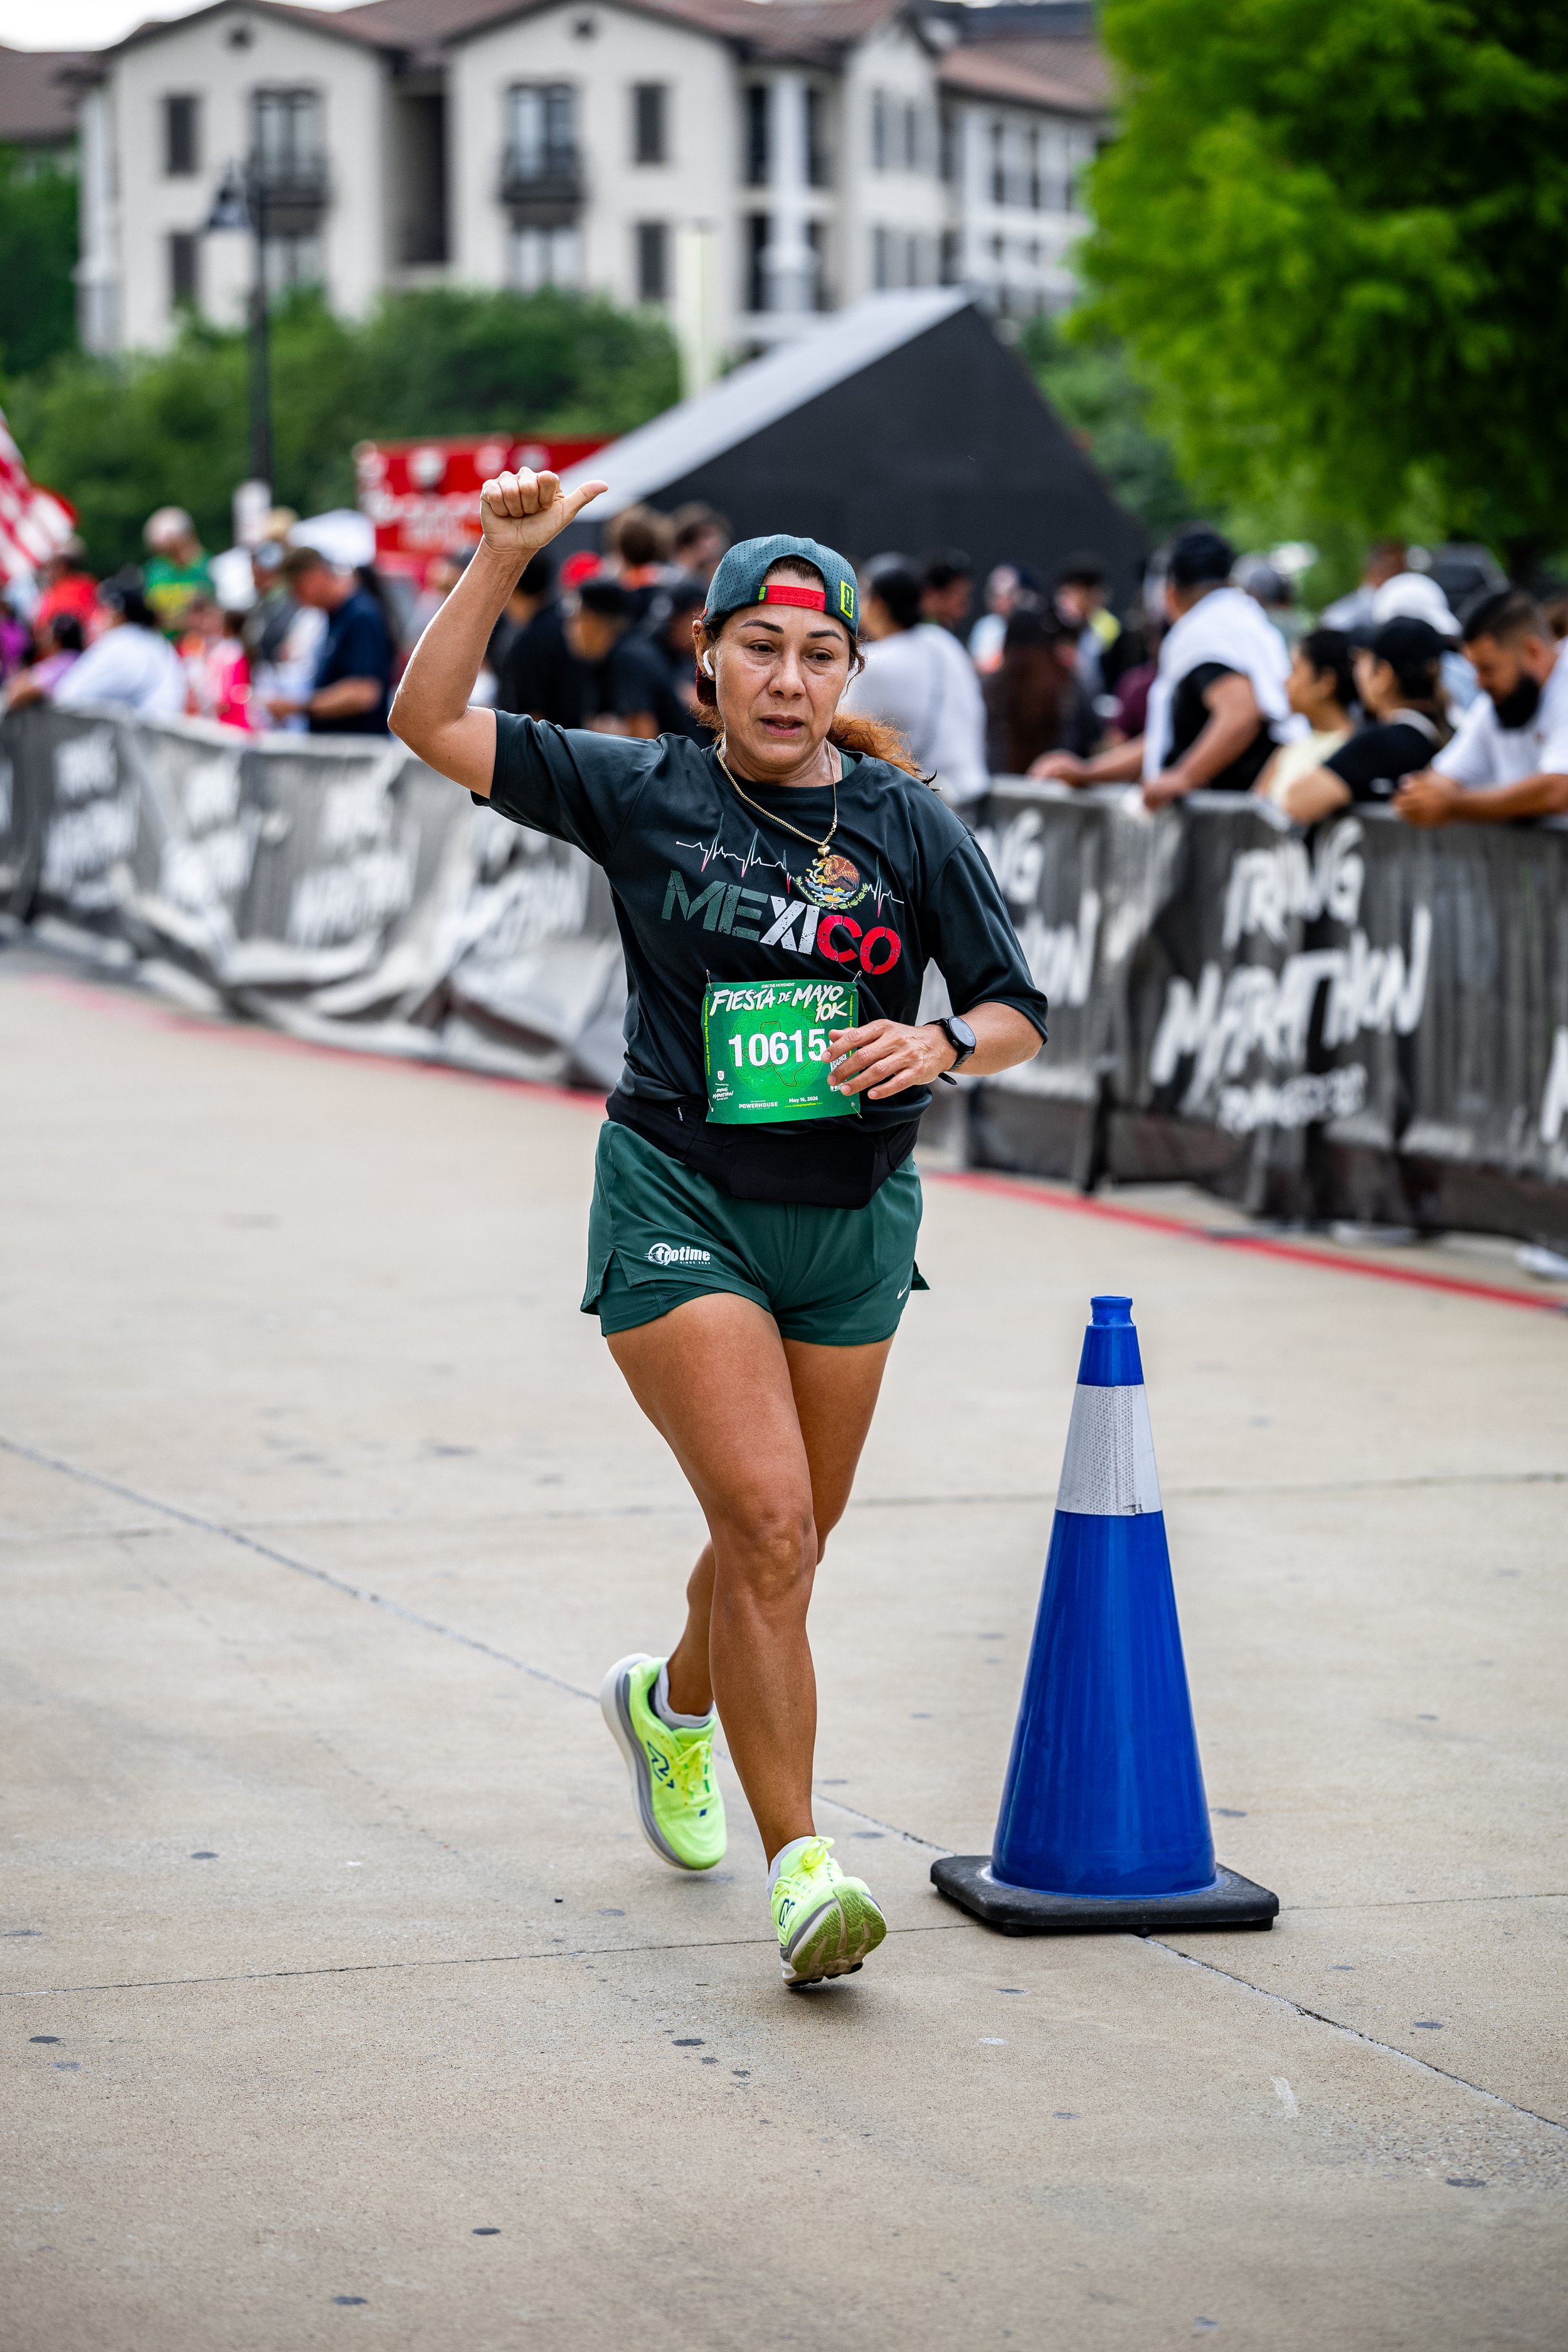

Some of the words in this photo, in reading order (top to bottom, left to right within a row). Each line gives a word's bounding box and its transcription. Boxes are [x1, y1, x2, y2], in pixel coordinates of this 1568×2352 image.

[661, 870, 902, 975] MEXICO
[709, 988, 776, 1016] FIESTA
[776, 991, 792, 1005] DE
[791, 983, 844, 1009] MAYO
[815, 1000, 848, 1023] 10K
[728, 1029, 833, 1067] 10615
